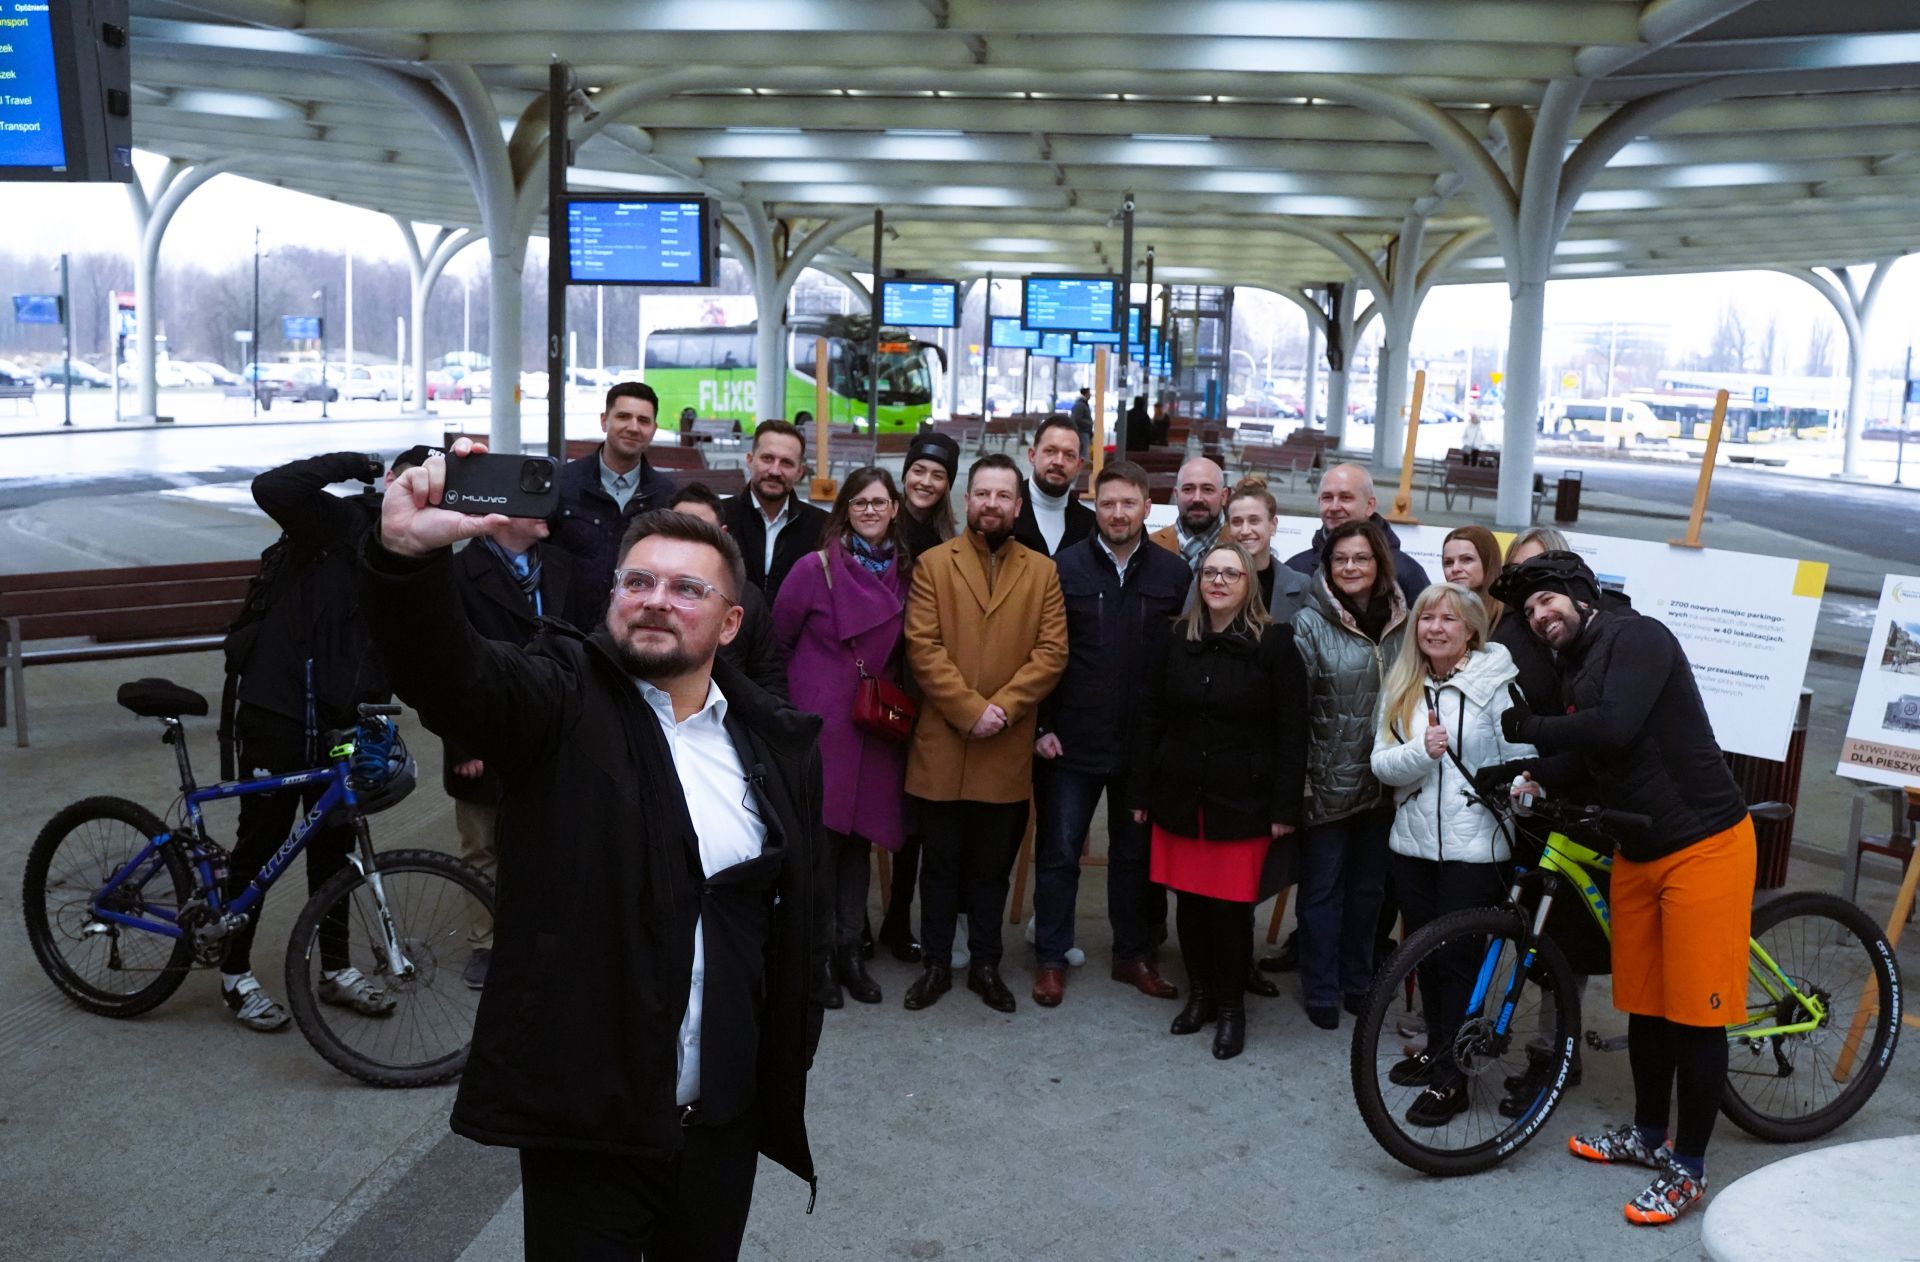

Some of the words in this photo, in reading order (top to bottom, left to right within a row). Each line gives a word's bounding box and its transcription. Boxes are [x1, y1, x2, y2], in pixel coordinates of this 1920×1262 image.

[4, 96, 32, 106] Travel
[551, 334, 558, 358] 3
[1668, 610, 1688, 619] wych
[1670, 600, 1689, 608] 2700
[1690, 602, 1720, 613] nowych
[1747, 611, 1784, 622] parkingo-
[1722, 627, 1732, 635] 40
[1734, 629, 1784, 643] lokalizacjach.
[1851, 752, 1874, 764] DLA
[258, 801, 323, 879] TREK
[1566, 1036, 1574, 1058] CST
[1556, 1058, 1570, 1090] JACK
[1532, 1089, 1559, 1128] RABBIT
